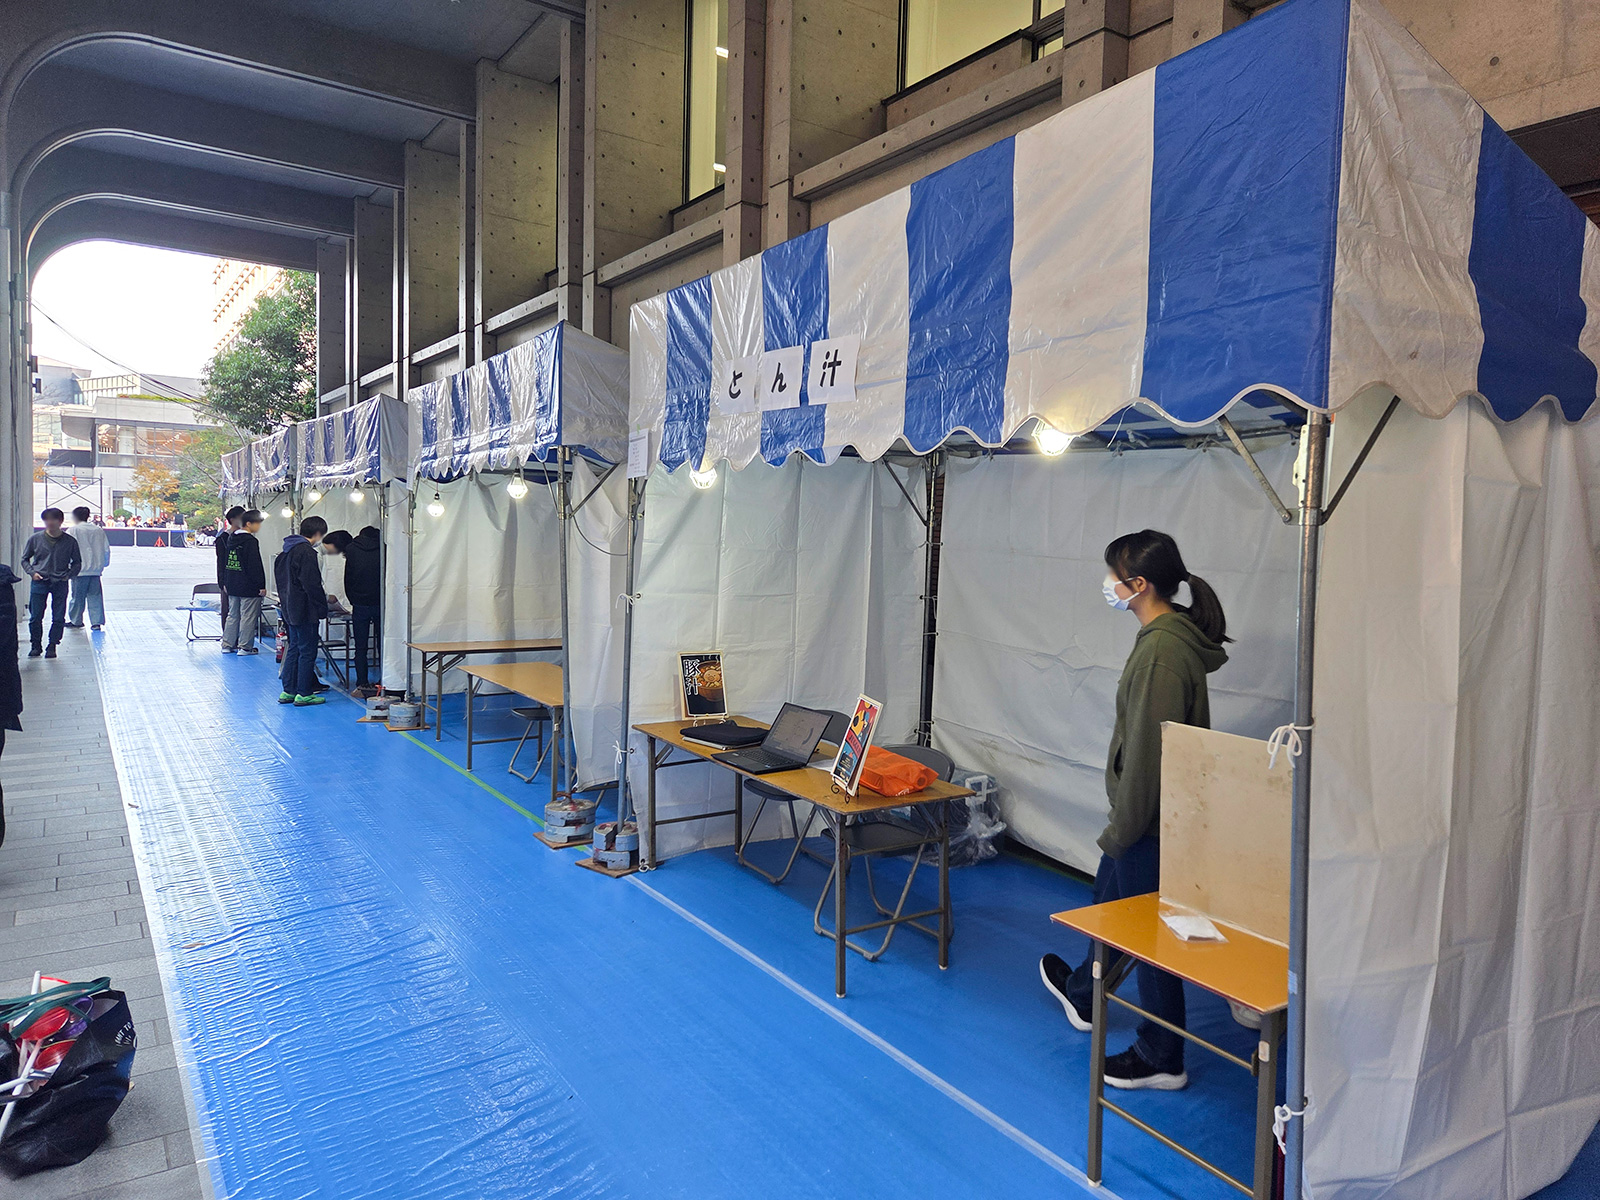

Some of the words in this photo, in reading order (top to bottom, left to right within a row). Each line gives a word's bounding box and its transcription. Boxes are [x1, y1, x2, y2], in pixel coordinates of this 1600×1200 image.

[728, 348, 842, 399] とん汁
[683, 658, 703, 695] 豚汁
